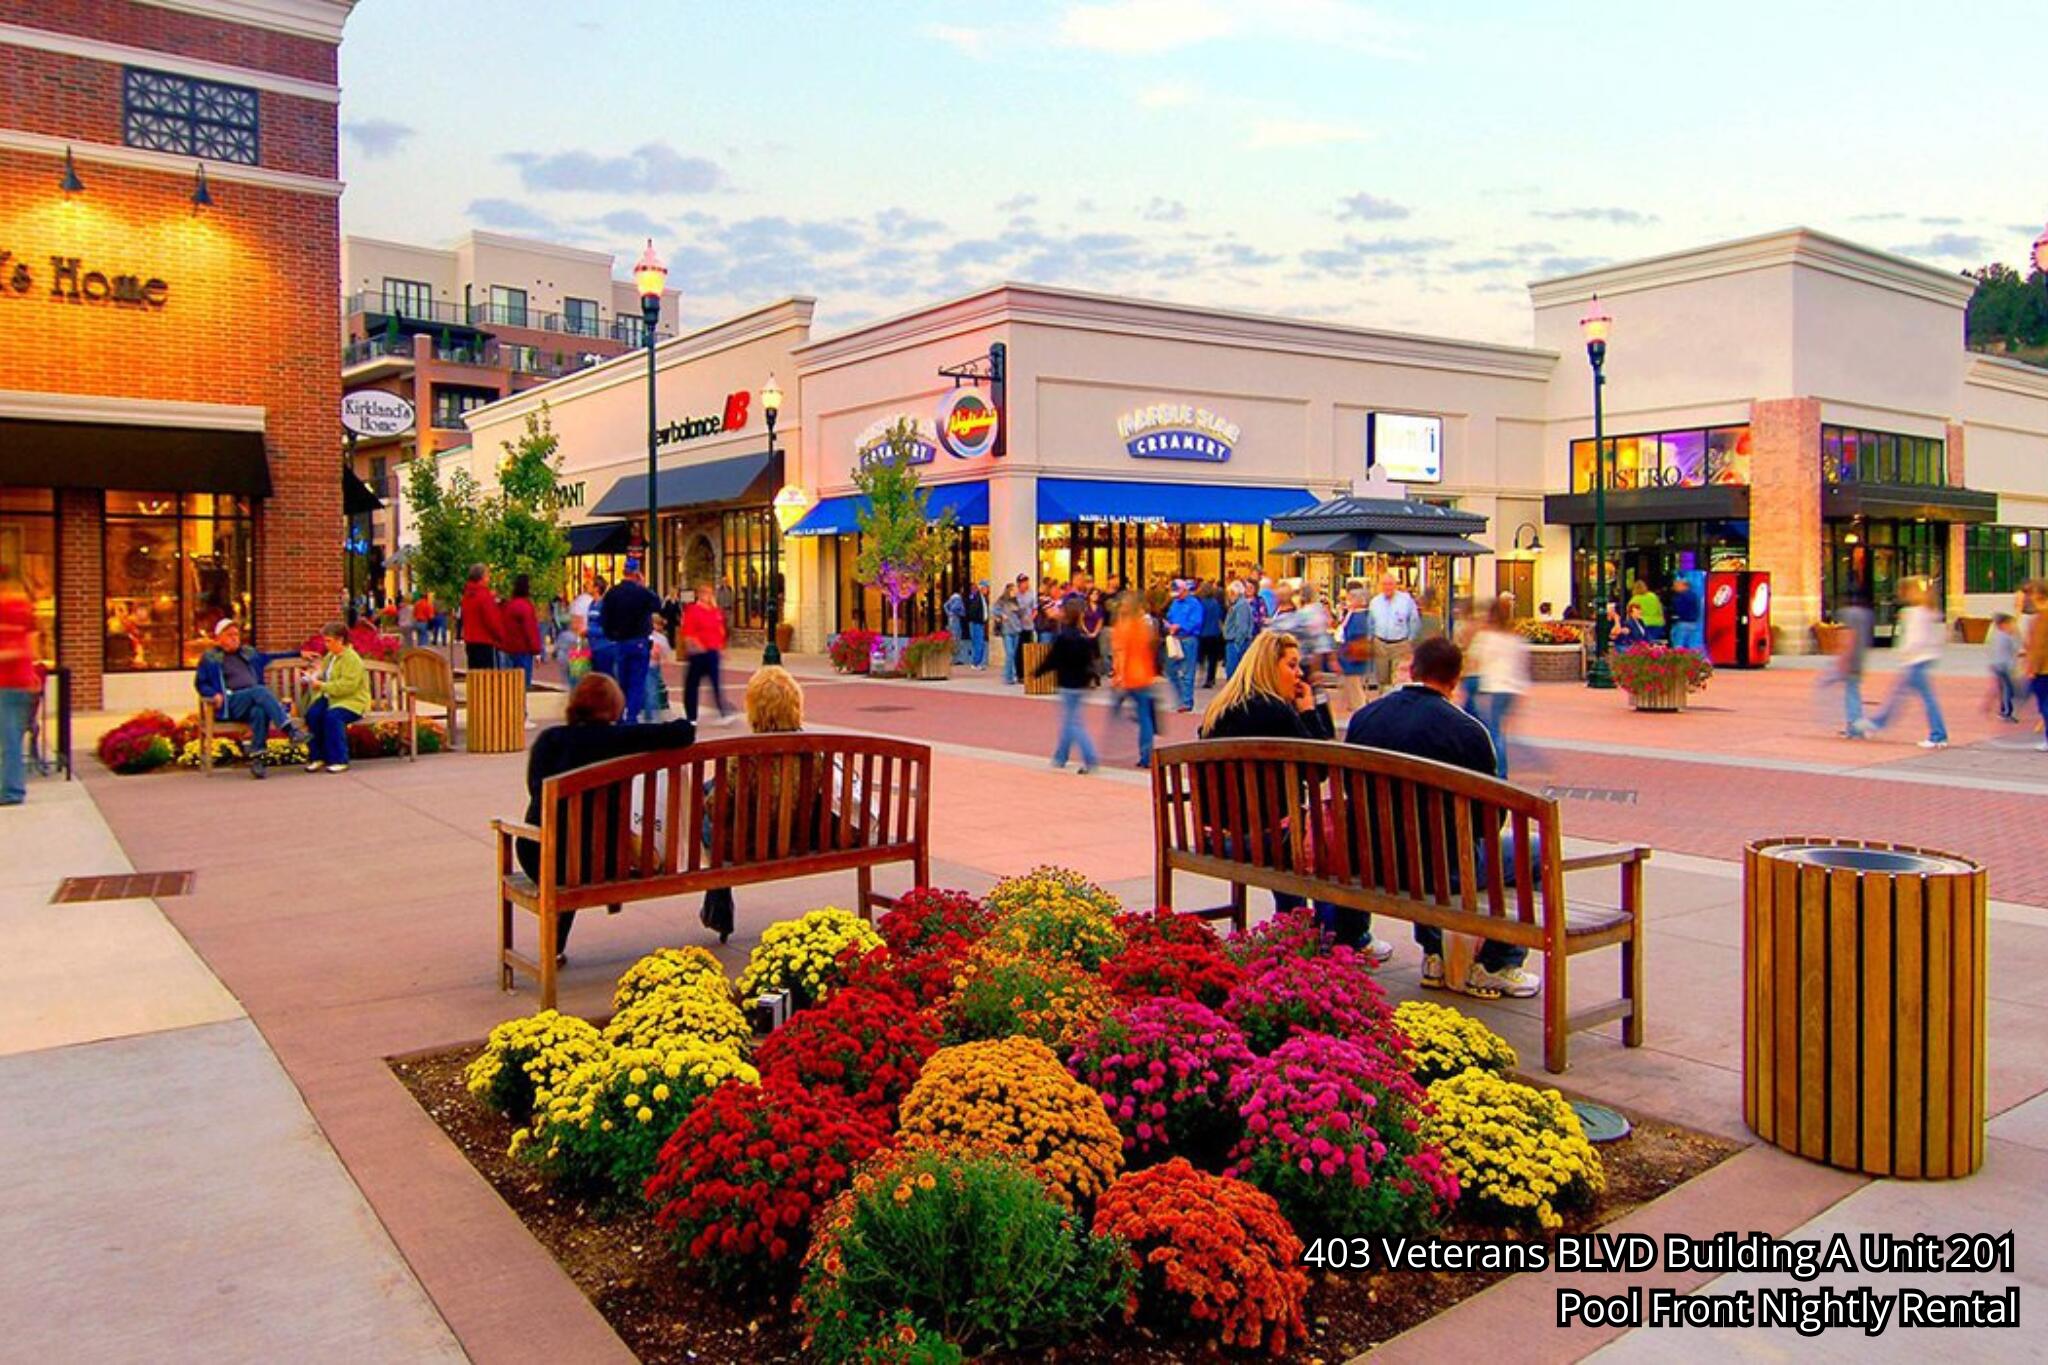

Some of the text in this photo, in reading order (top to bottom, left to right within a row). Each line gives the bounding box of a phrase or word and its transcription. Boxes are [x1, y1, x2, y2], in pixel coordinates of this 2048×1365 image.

[50, 255, 169, 311] Home
[345, 399, 410, 420] Kirkland's
[360, 416, 397, 433] Home
[1136, 433, 1227, 459] CREAMERY
